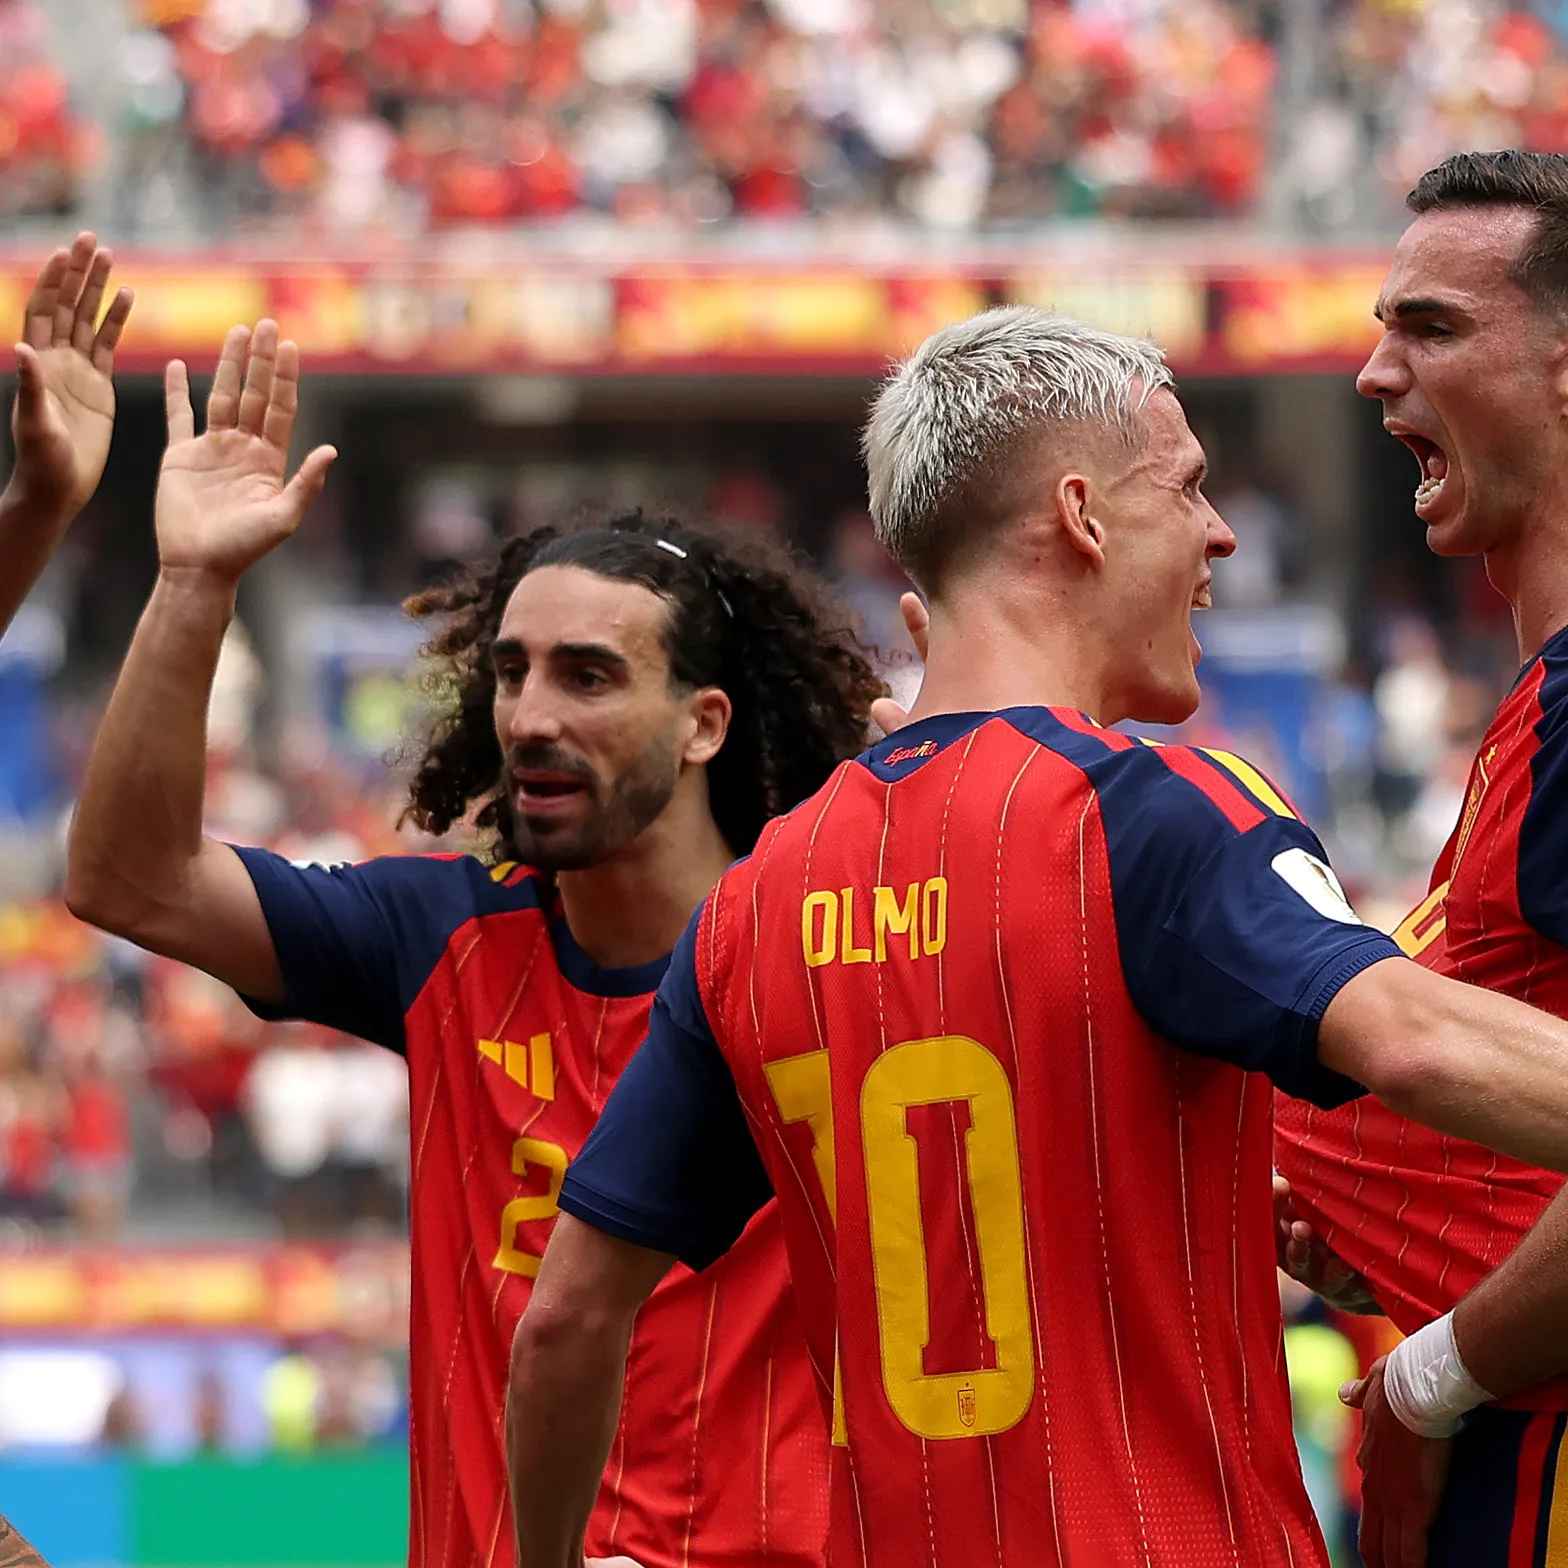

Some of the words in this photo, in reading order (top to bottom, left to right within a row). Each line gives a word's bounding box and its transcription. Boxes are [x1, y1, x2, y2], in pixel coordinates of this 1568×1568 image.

[884, 740, 939, 767] España
[801, 876, 948, 968] OLMO
[763, 1035, 1037, 1447] 10
